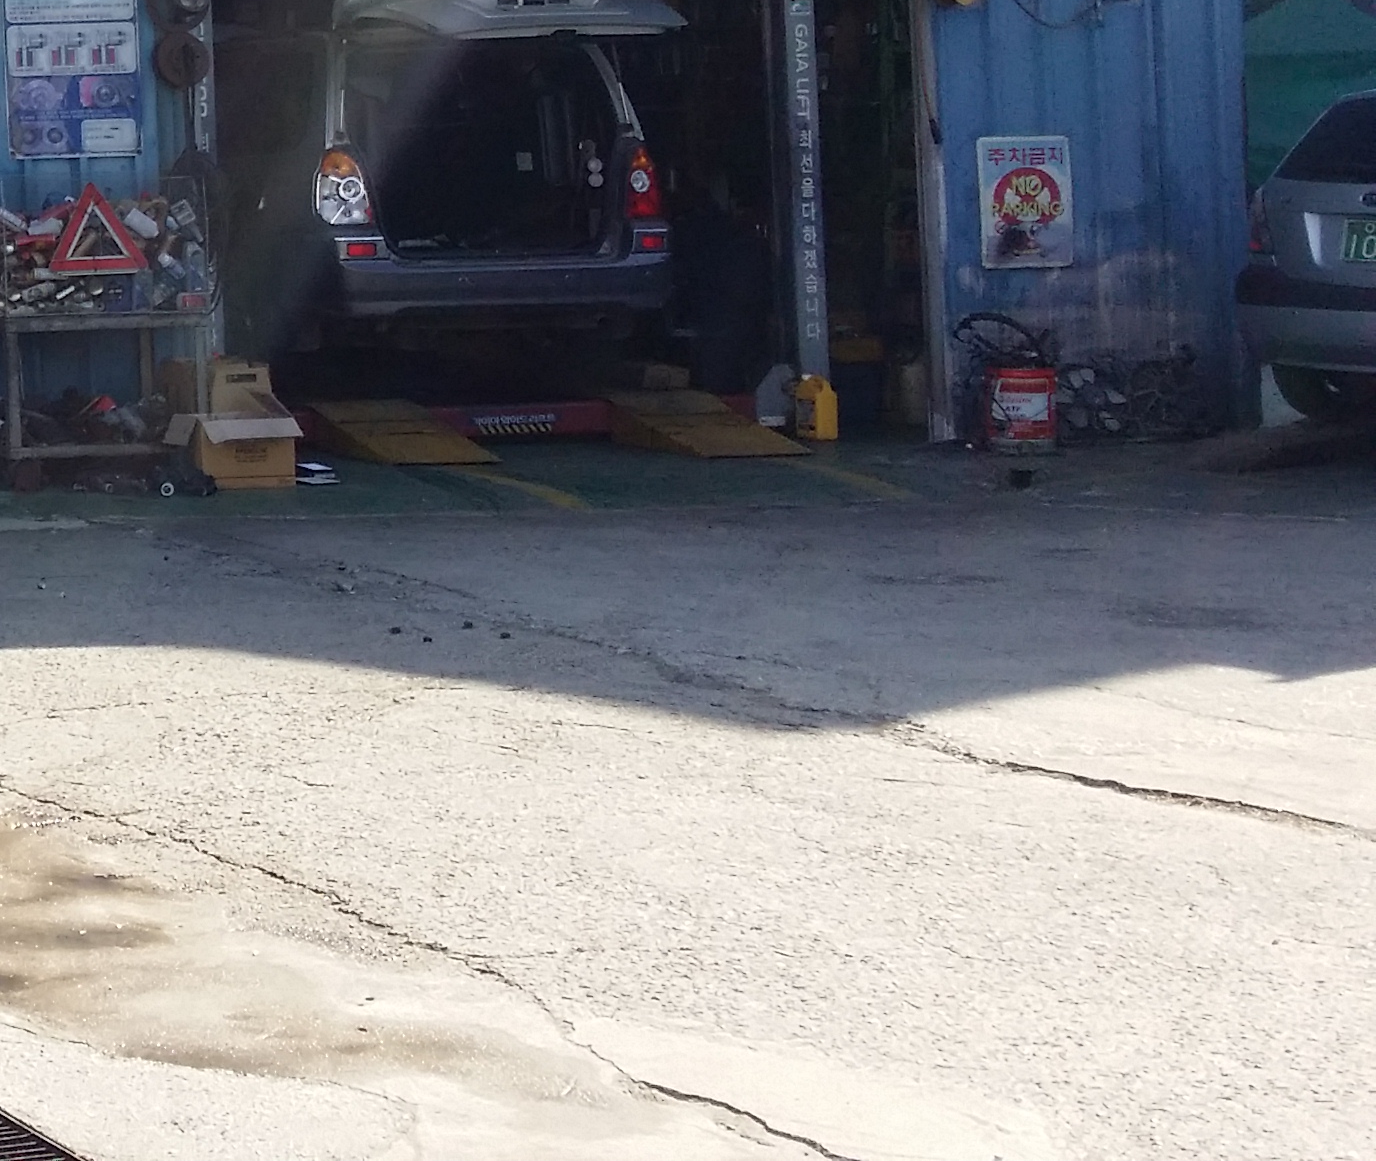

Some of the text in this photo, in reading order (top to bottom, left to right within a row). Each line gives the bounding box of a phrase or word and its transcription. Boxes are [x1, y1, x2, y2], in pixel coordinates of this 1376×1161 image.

[988, 146, 1063, 166] 주차금지
[1011, 174, 1044, 197] NO
[991, 201, 1065, 218] PARKING
